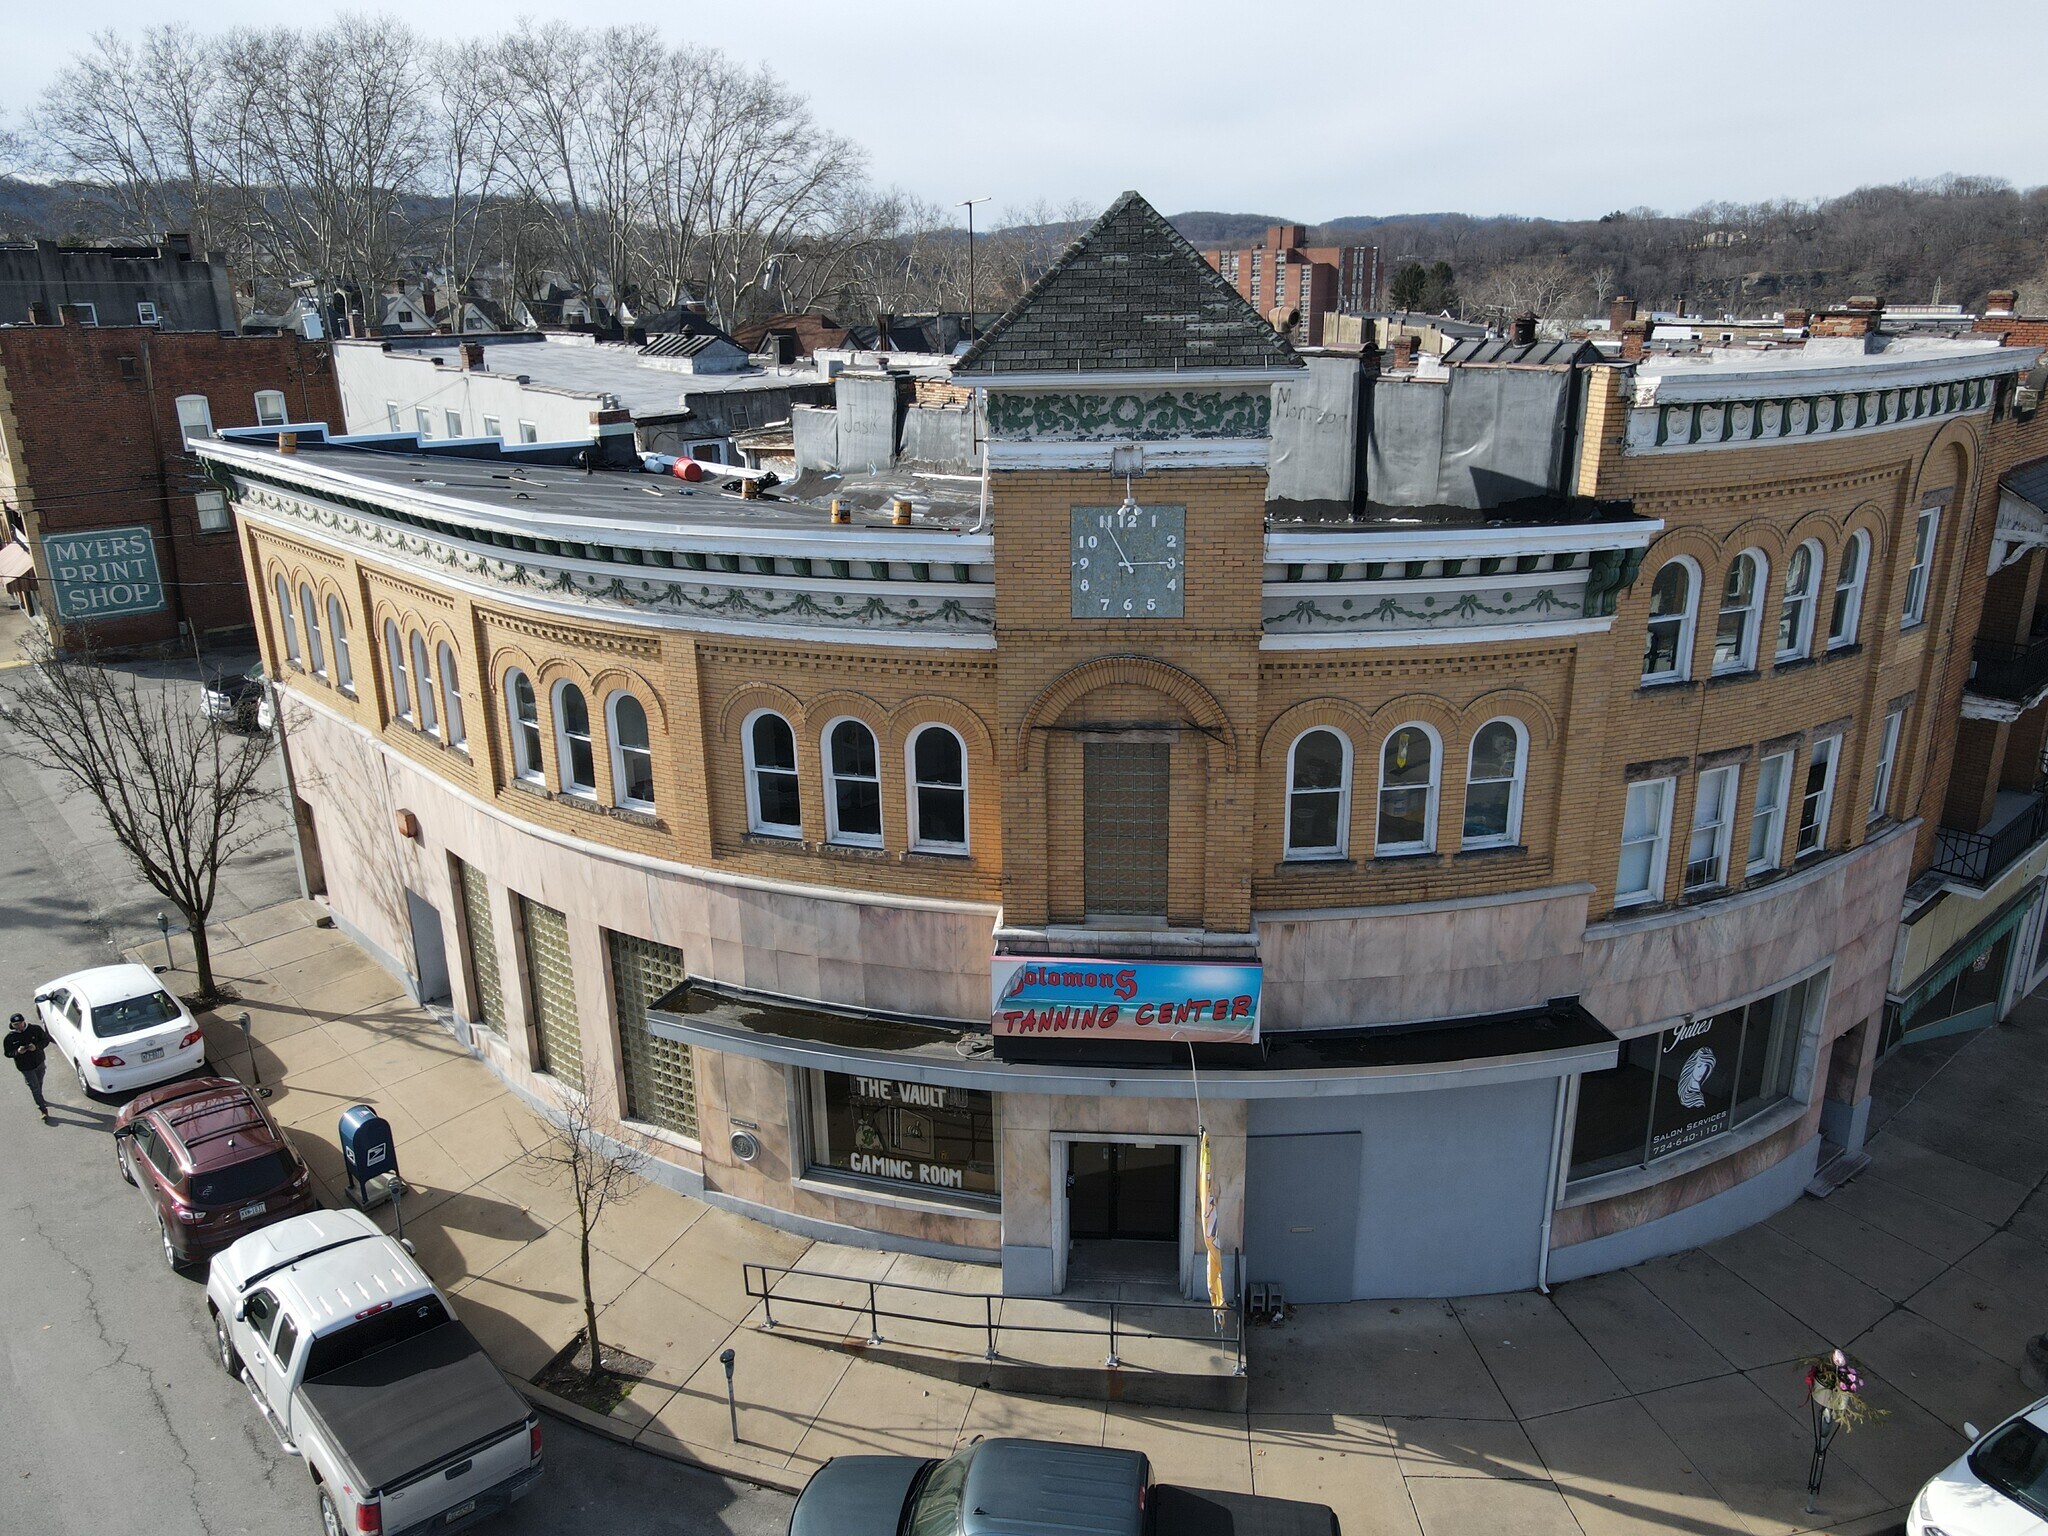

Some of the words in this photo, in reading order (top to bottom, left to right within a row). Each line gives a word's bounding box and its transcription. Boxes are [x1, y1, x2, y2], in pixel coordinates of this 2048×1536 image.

[1100, 515, 1112, 528] 11
[1118, 515, 1137, 528] 12
[1151, 514, 1157, 527] 1
[1078, 535, 1098, 549] 10
[1166, 535, 1177, 547] 2
[54, 535, 146, 562] MYERS
[1079, 557, 1090, 570] 9
[1166, 557, 1176, 569] 3
[59, 558, 147, 587] PRINT
[1080, 579, 1090, 591] 8
[1166, 578, 1177, 591] 4
[69, 584, 150, 611] SHOP
[1146, 598, 1156, 610] 5
[1100, 598, 1110, 611] 7
[1123, 598, 1133, 611] 6
[1003, 1004, 1120, 1035] TANNING
[1135, 995, 1252, 1027] CENTER
[856, 1077, 892, 1100] THE
[898, 1082, 947, 1108] VAULT
[1653, 1127, 1683, 1144] SALON
[1686, 1110, 1727, 1132] SERVICES
[850, 1152, 913, 1180] GAMING
[919, 1163, 963, 1188] ROOM
